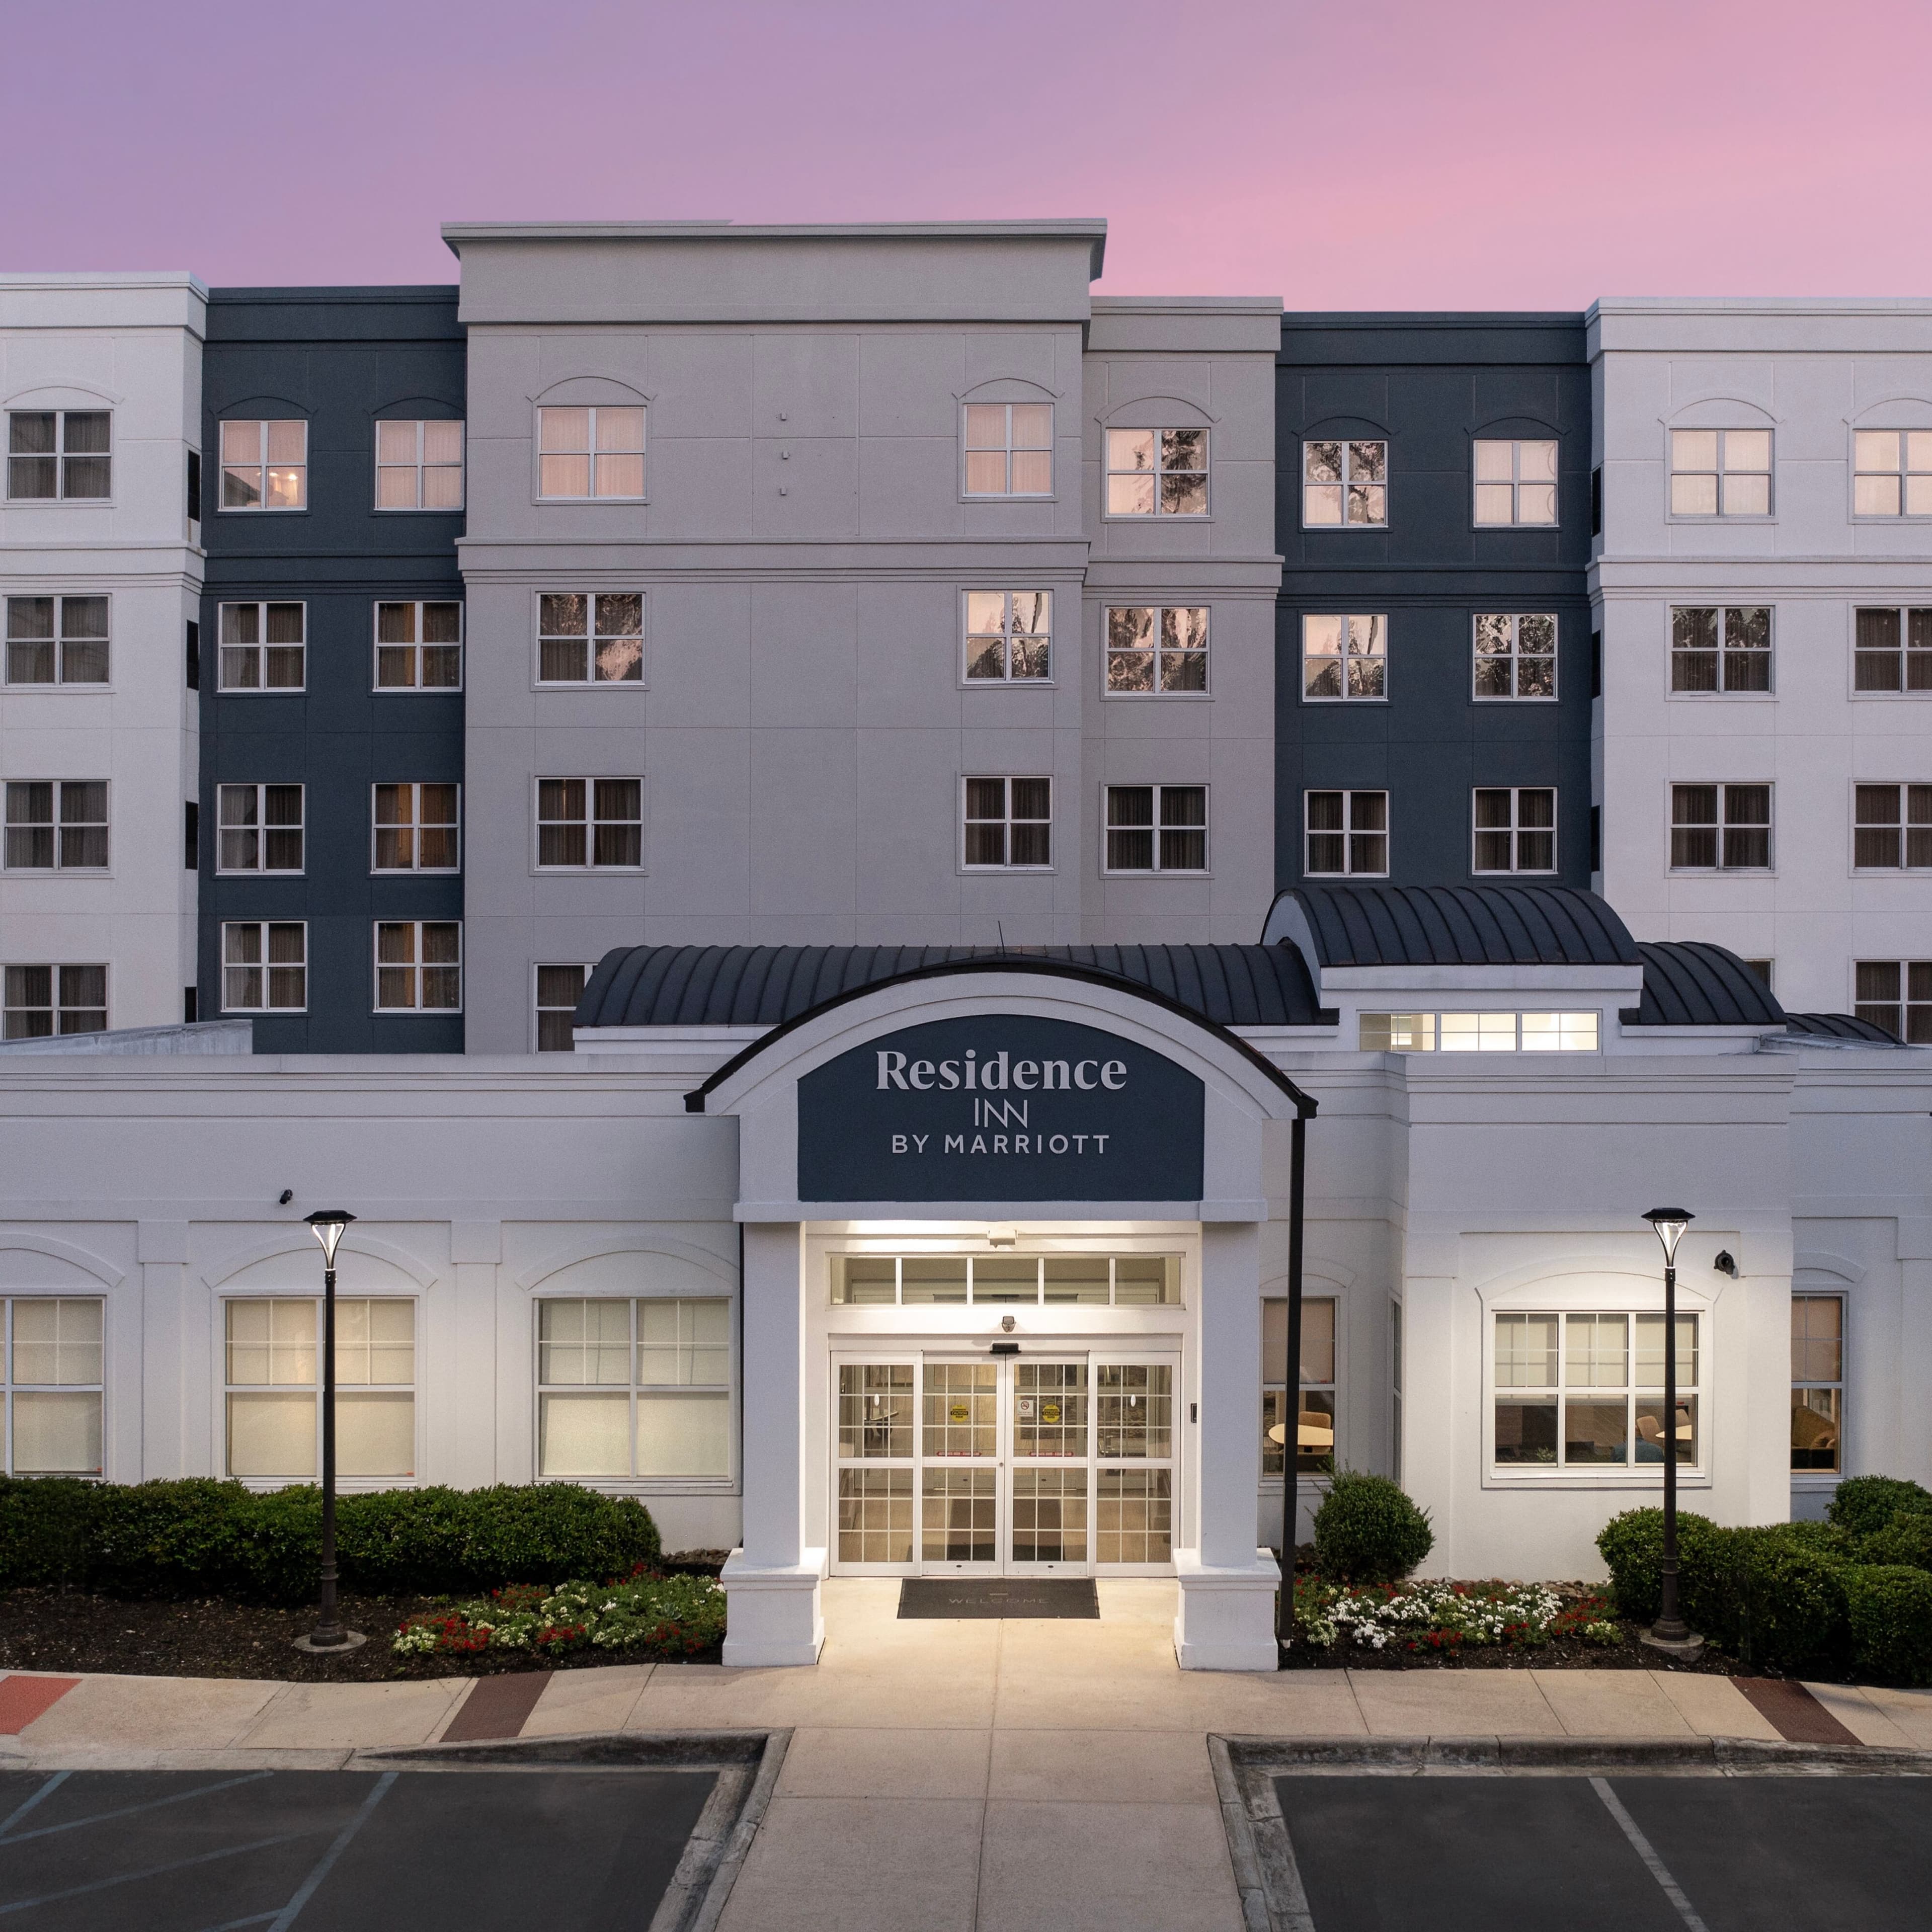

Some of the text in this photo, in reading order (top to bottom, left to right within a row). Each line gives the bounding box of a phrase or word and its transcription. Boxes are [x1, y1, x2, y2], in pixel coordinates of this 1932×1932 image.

[876, 1050, 1127, 1090] Residence
[975, 1098, 1028, 1129] INN
[892, 1135, 1109, 1154] BY MARRIOTT
